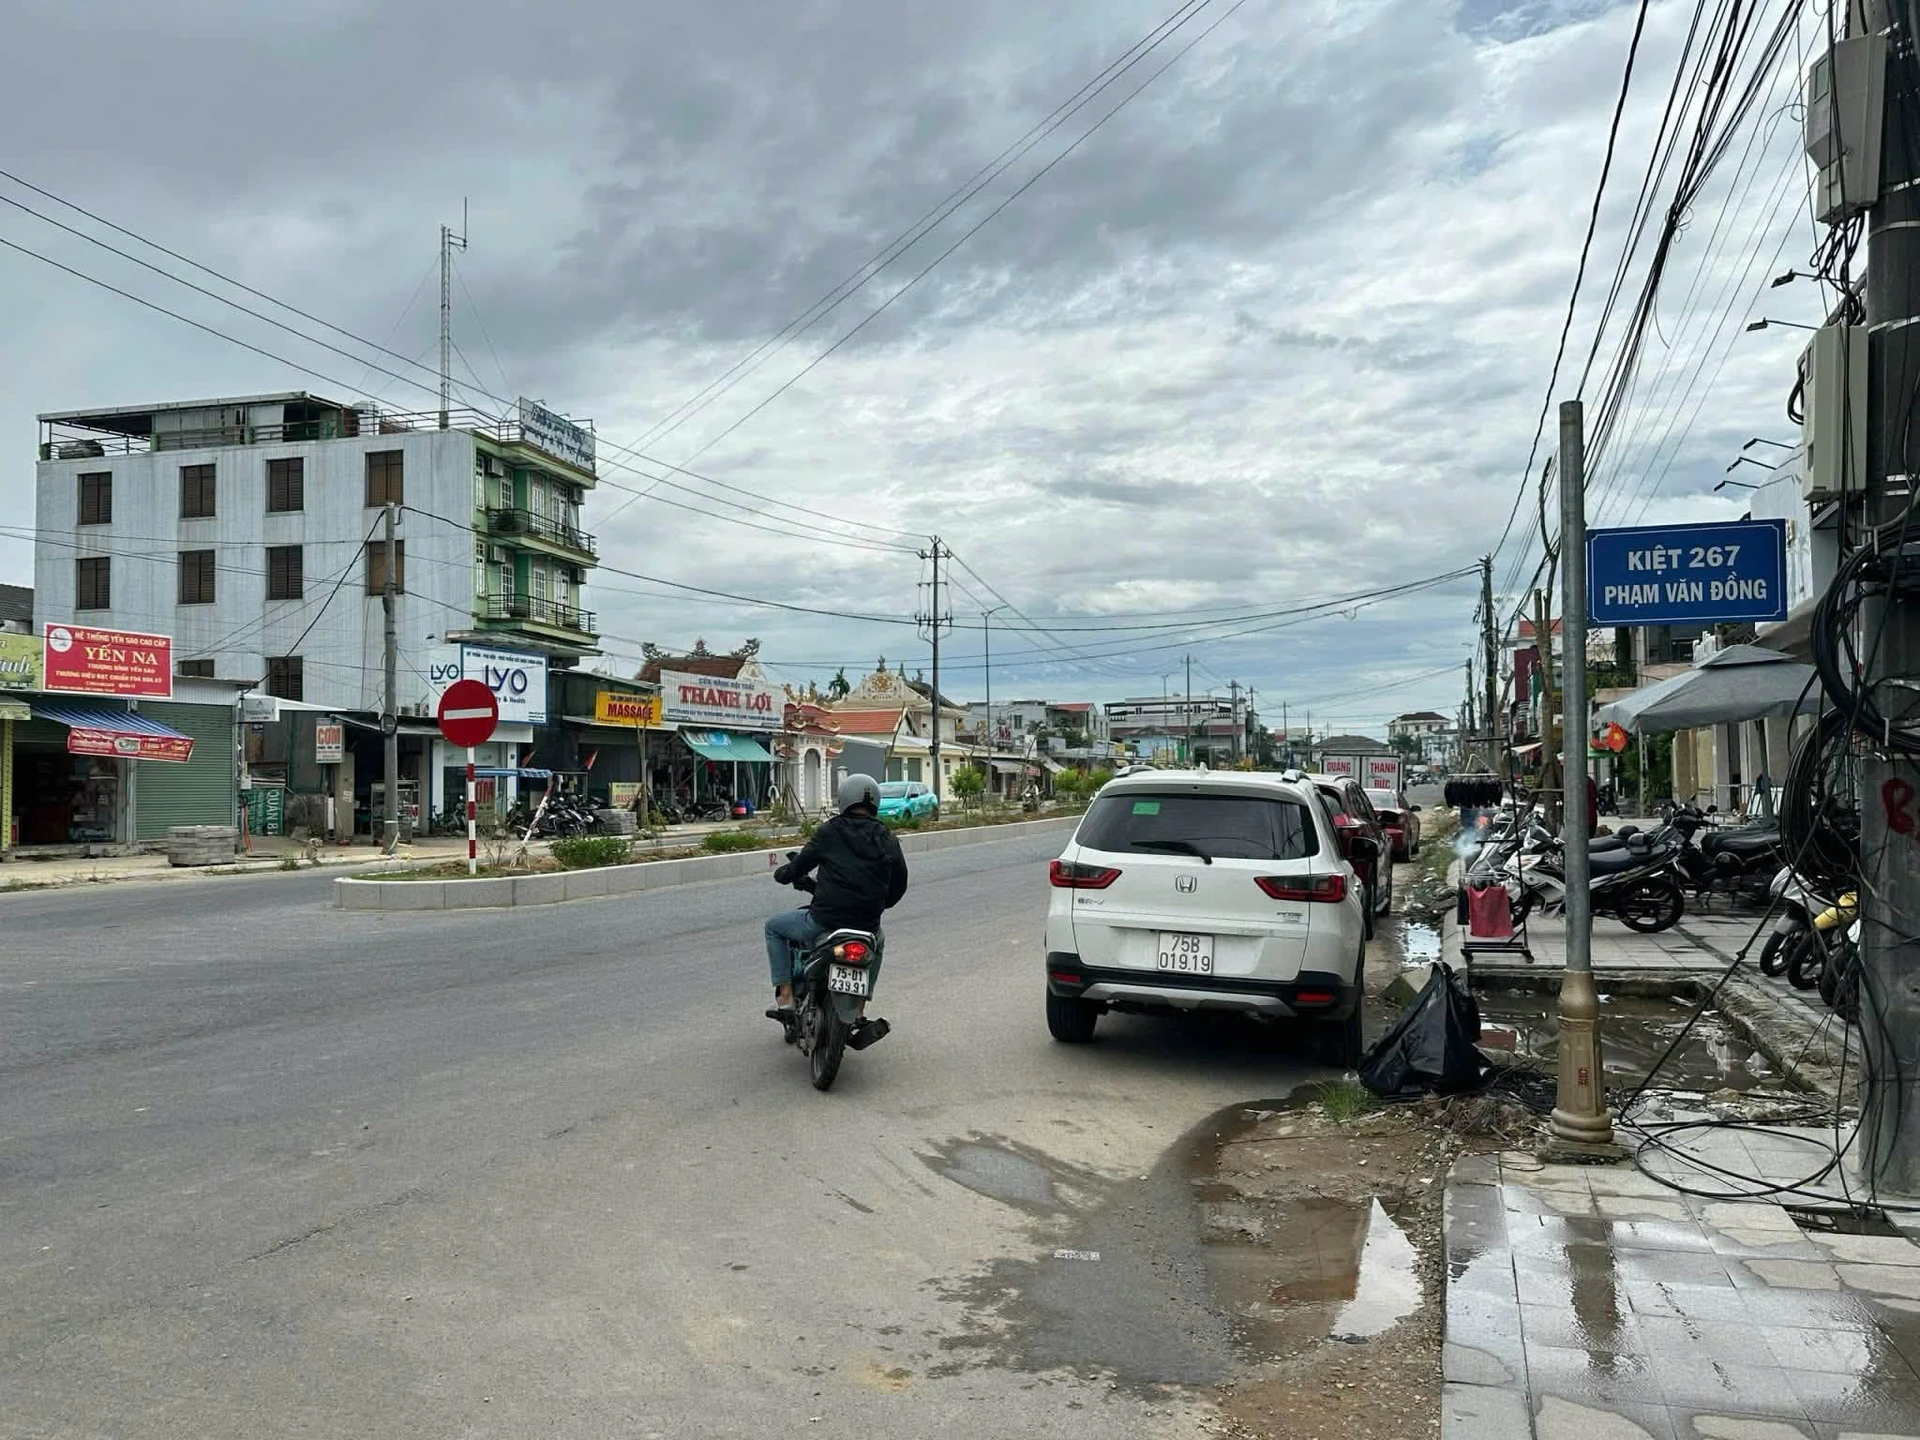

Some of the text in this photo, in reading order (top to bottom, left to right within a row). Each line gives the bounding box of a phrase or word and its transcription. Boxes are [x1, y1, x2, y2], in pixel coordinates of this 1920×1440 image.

[1628, 545, 1741, 575] KIỆT 267
[1604, 571, 1768, 608] PHẠM VĂN ĐỒNG
[84, 643, 158, 665] YẾN NA
[430, 664, 460, 680] LYO
[485, 665, 528, 695] LYO
[678, 685, 772, 714] THANH LỢI
[607, 702, 653, 720] MASSAGE
[1370, 762, 1396, 773] THANH
[1171, 935, 1201, 953] 75B
[1159, 952, 1211, 973] 019.19
